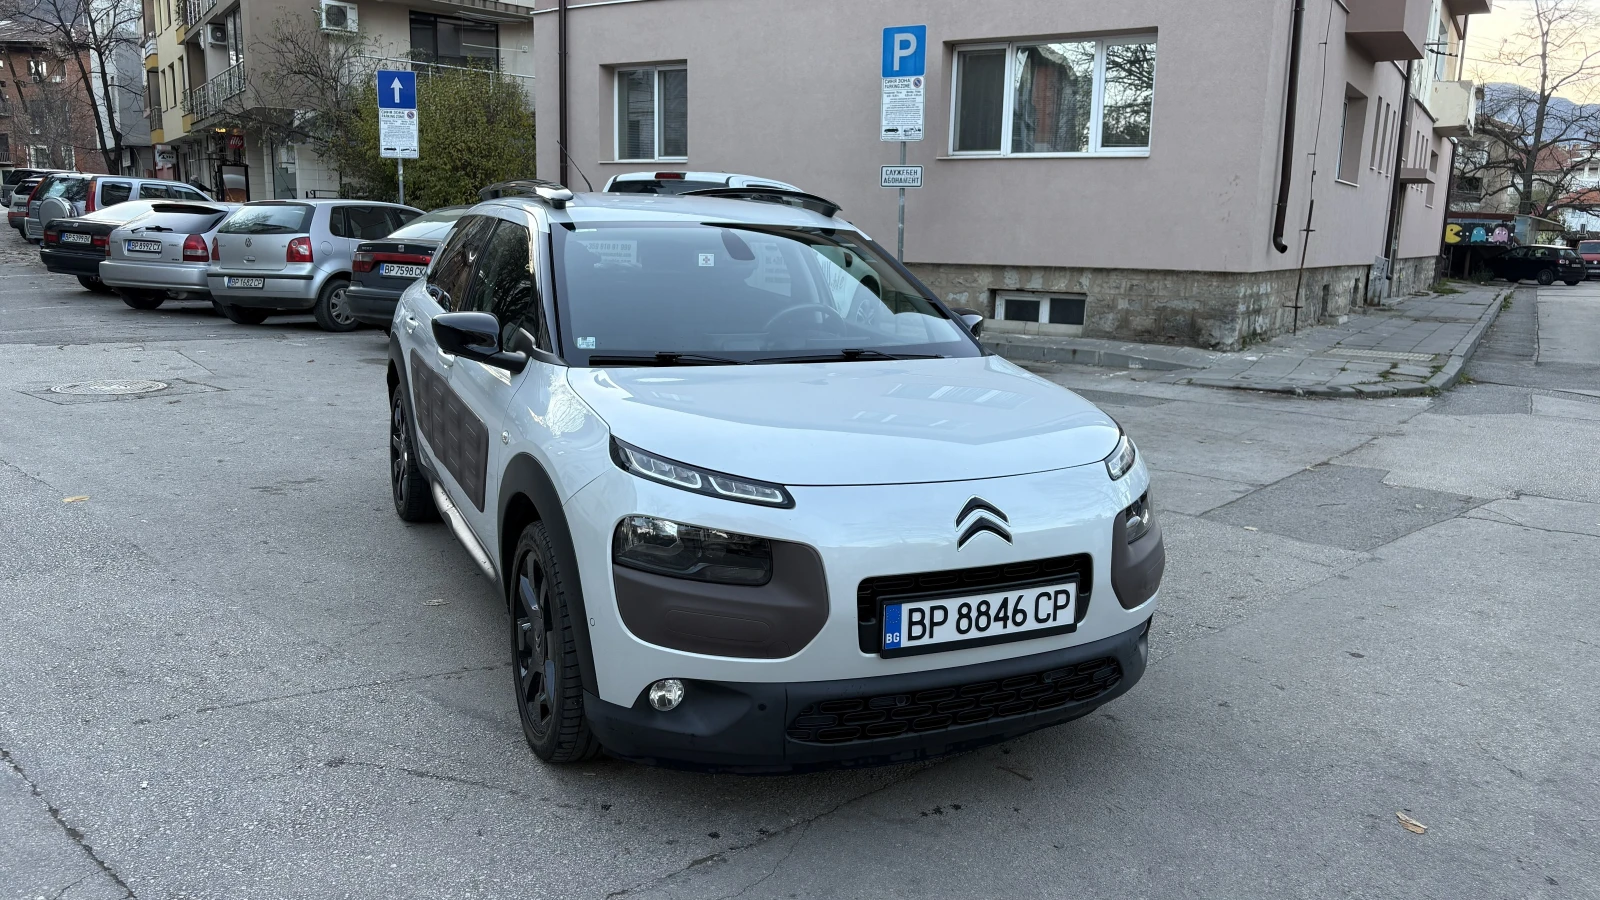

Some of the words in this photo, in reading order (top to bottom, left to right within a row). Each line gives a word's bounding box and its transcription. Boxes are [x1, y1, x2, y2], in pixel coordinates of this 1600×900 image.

[893, 32, 917, 71] P
[230, 136, 243, 146] illy
[885, 168, 918, 176] СЛУЖЕБЕН
[883, 176, 920, 184] АБОНАМЕНТ
[384, 264, 395, 274] BP
[395, 265, 413, 275] 7598
[907, 604, 948, 641] BP
[956, 594, 1027, 635] 8846
[1034, 589, 1071, 624] CP
[886, 632, 900, 644] BG
